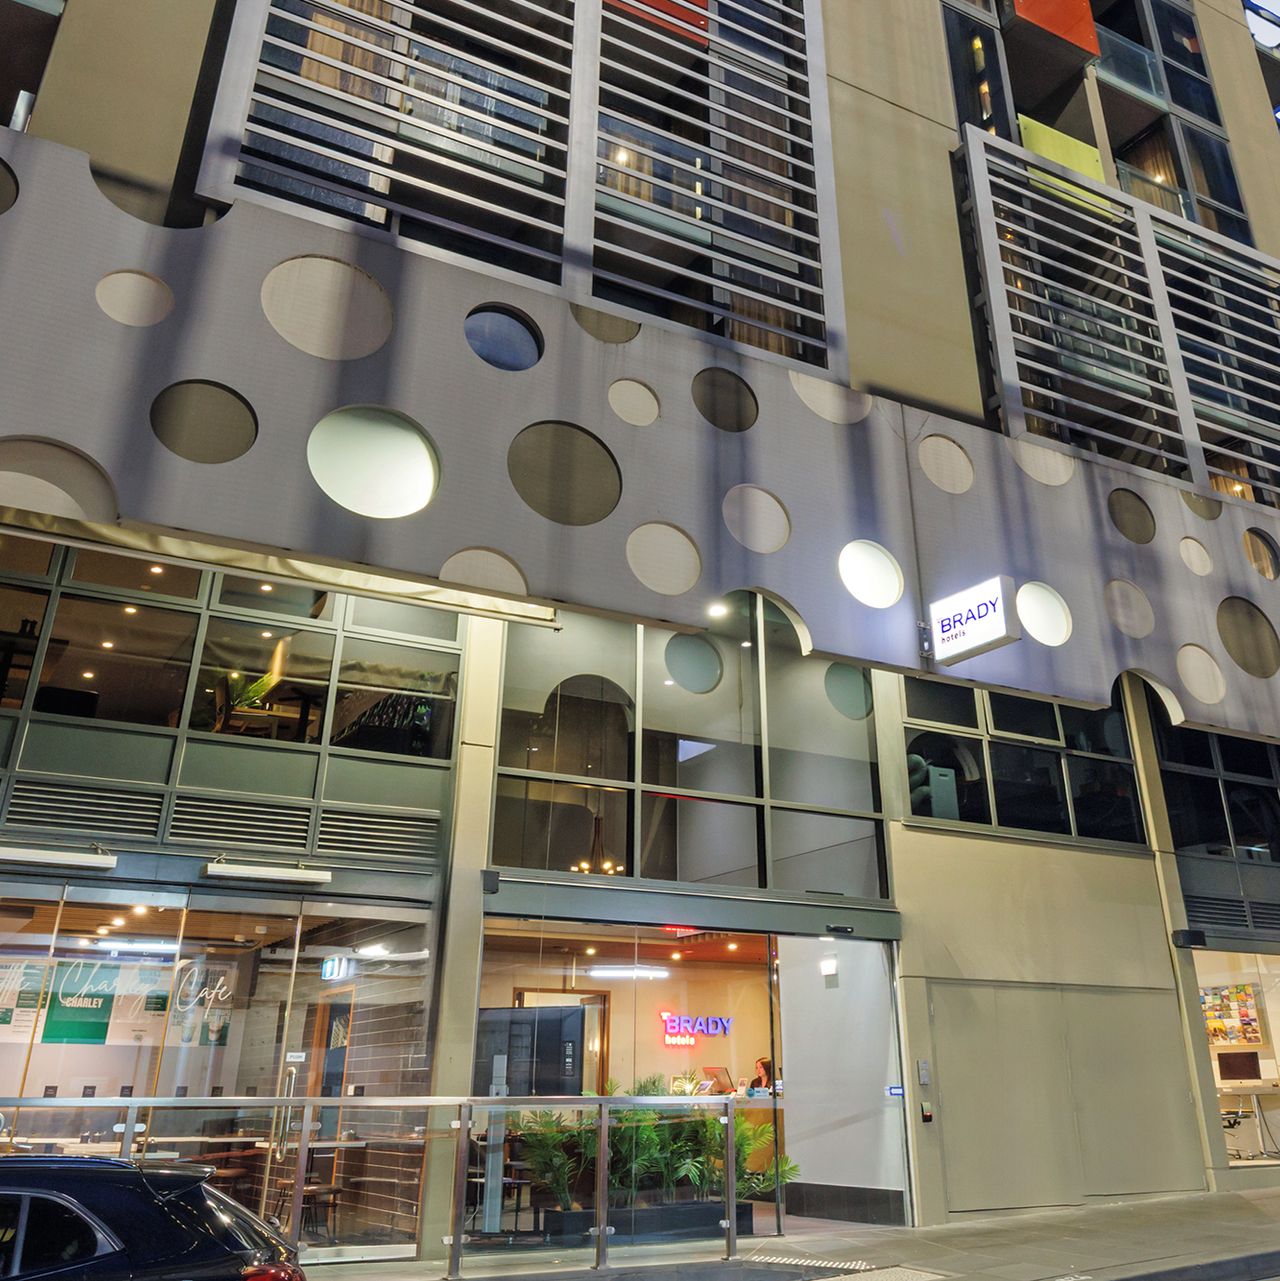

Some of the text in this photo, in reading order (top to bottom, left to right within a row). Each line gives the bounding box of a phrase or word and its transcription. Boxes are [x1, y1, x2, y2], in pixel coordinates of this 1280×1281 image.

[940, 597, 999, 634] BRADY
[941, 630, 966, 644] hotels
[176, 967, 232, 1019] Cafe
[65, 996, 104, 1009] CHARLEY
[665, 1015, 734, 1036] BRADY
[664, 1033, 696, 1046] hotels
